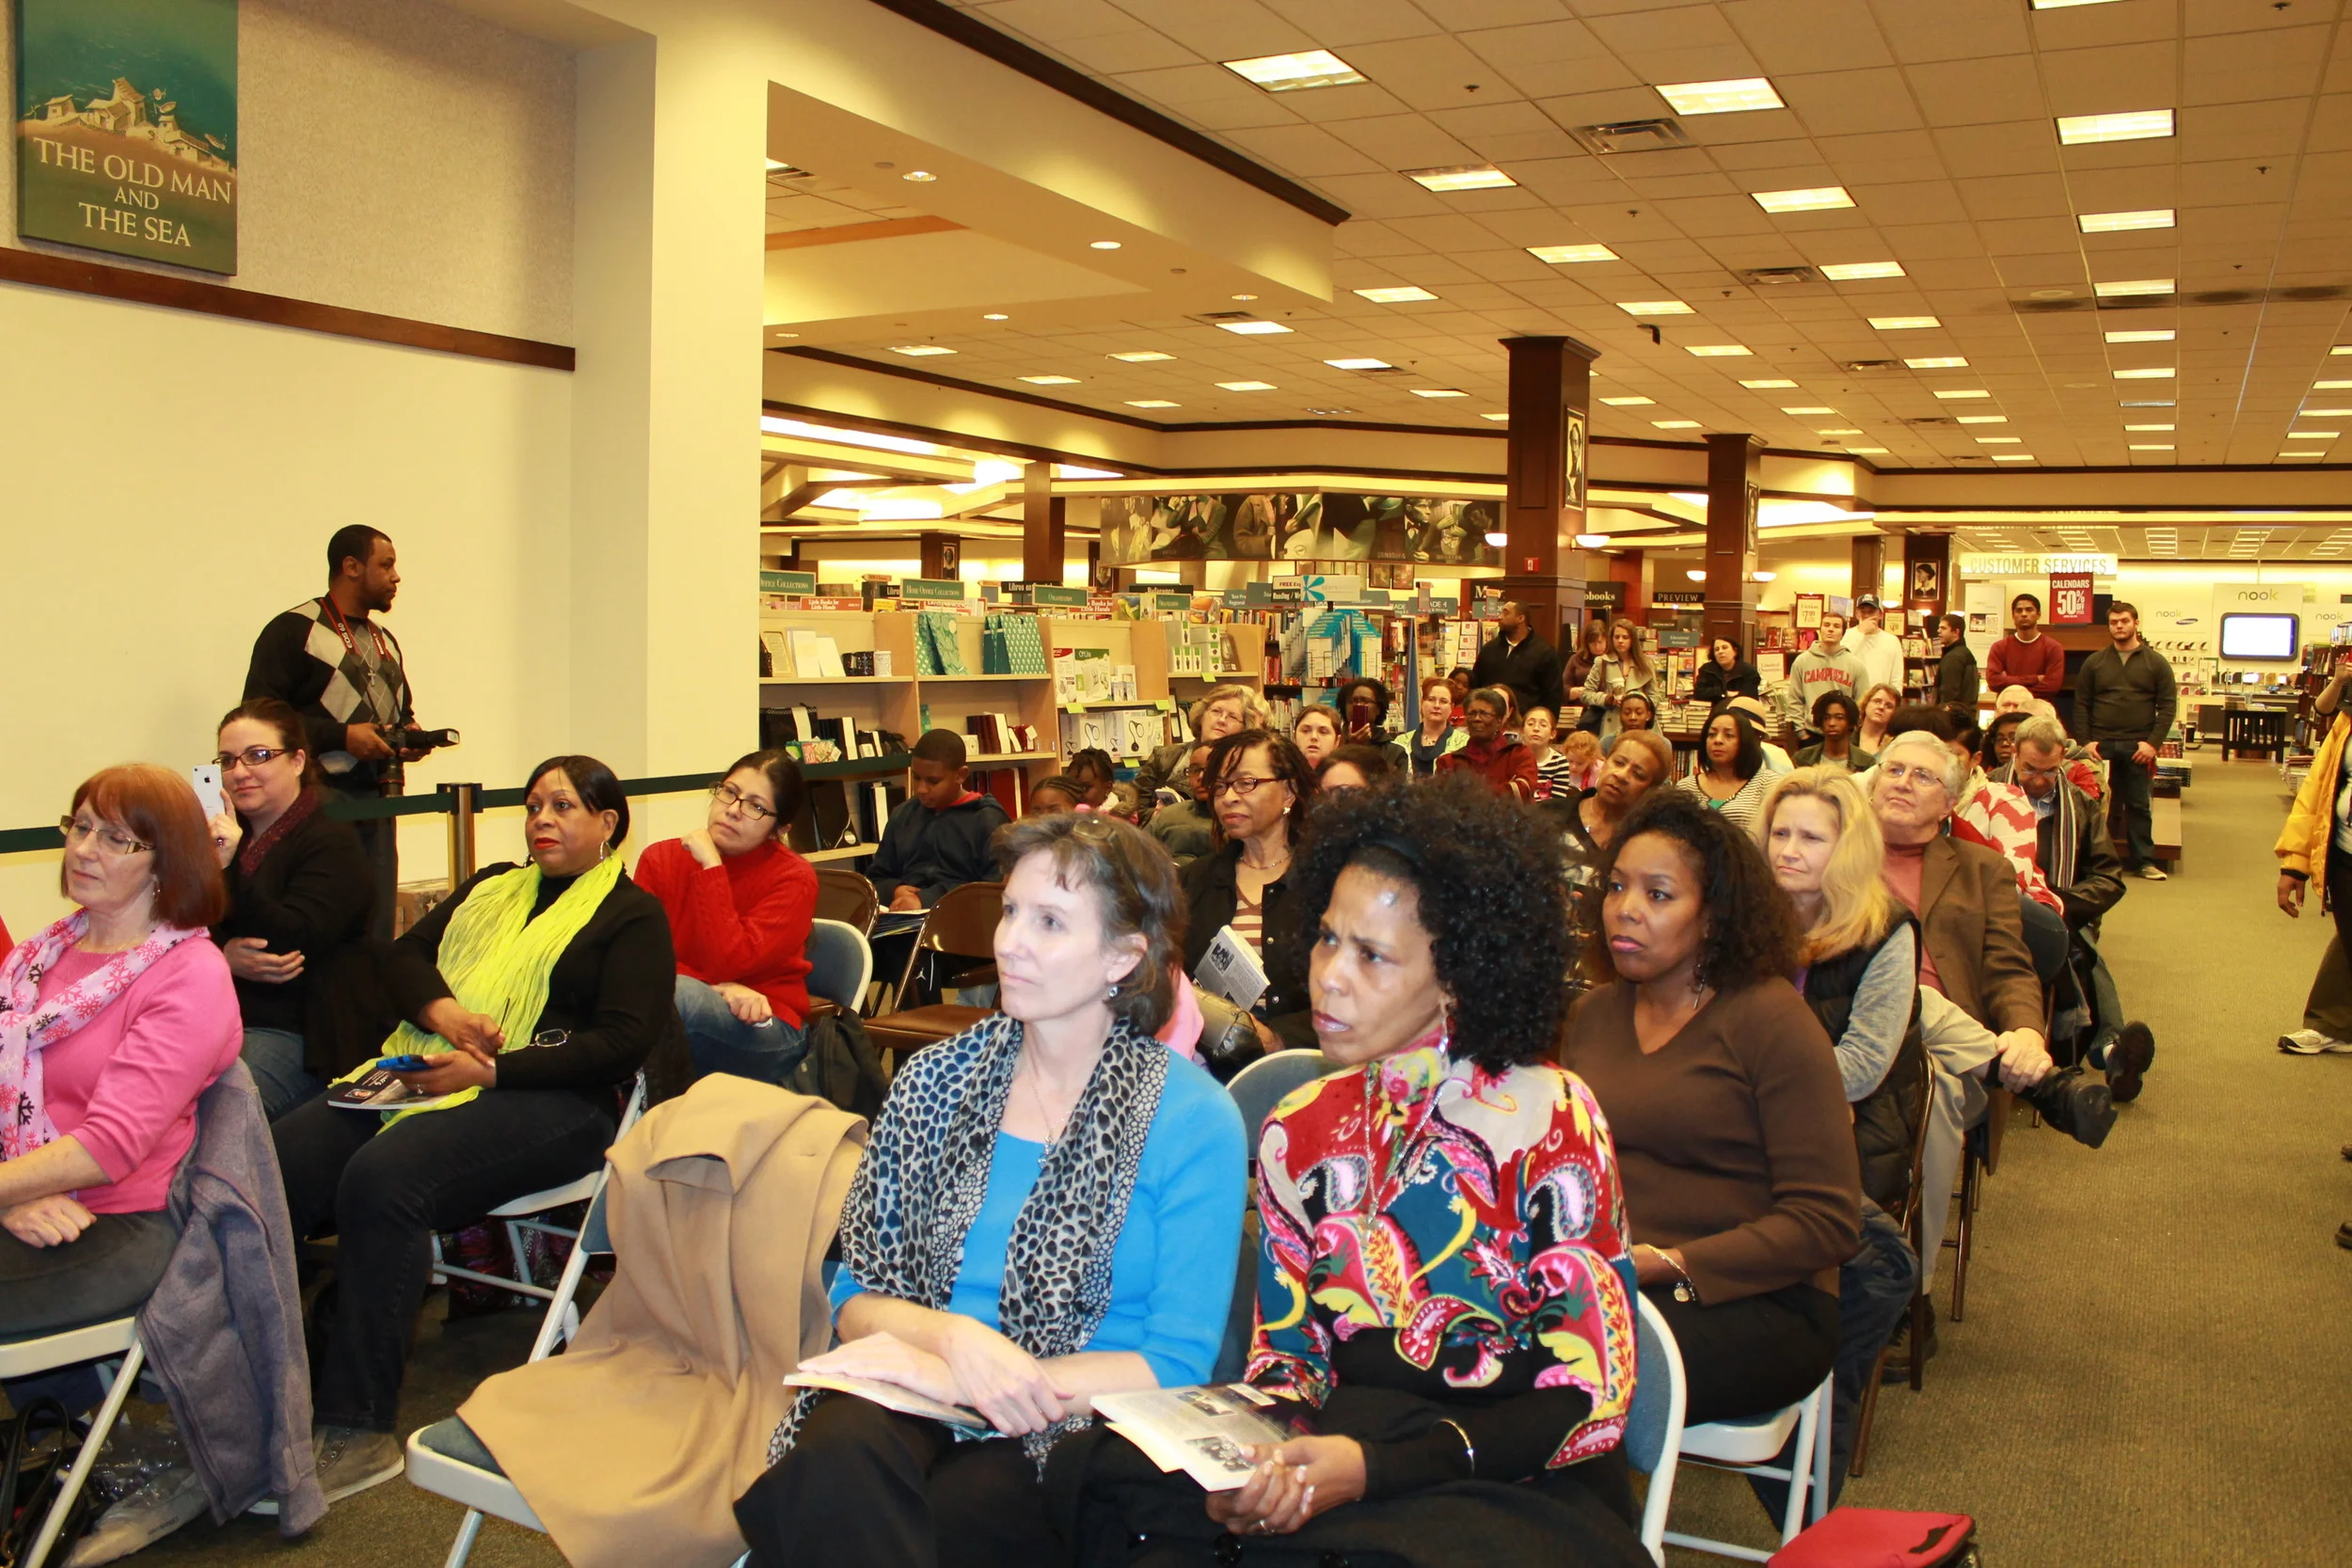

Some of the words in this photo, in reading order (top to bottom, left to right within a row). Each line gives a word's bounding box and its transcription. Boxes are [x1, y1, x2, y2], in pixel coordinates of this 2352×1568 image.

[33, 137, 96, 174] THE
[103, 155, 164, 188] OLD
[170, 170, 231, 204] MAN
[114, 186, 159, 211] AND
[79, 202, 137, 237] THE
[144, 217, 191, 247] SEA
[1970, 558, 2040, 574] CUSTOMER
[2043, 558, 2107, 575] SERVICES
[1009, 582, 1025, 592] Libros
[2052, 579, 2090, 589] CALENDARS
[1658, 593, 1699, 602] PREVIEW
[2237, 588, 2279, 601] nook
[2155, 610, 2182, 618] nook
[2315, 611, 2344, 621] nook
[1804, 667, 1852, 688] CAMPBELL
